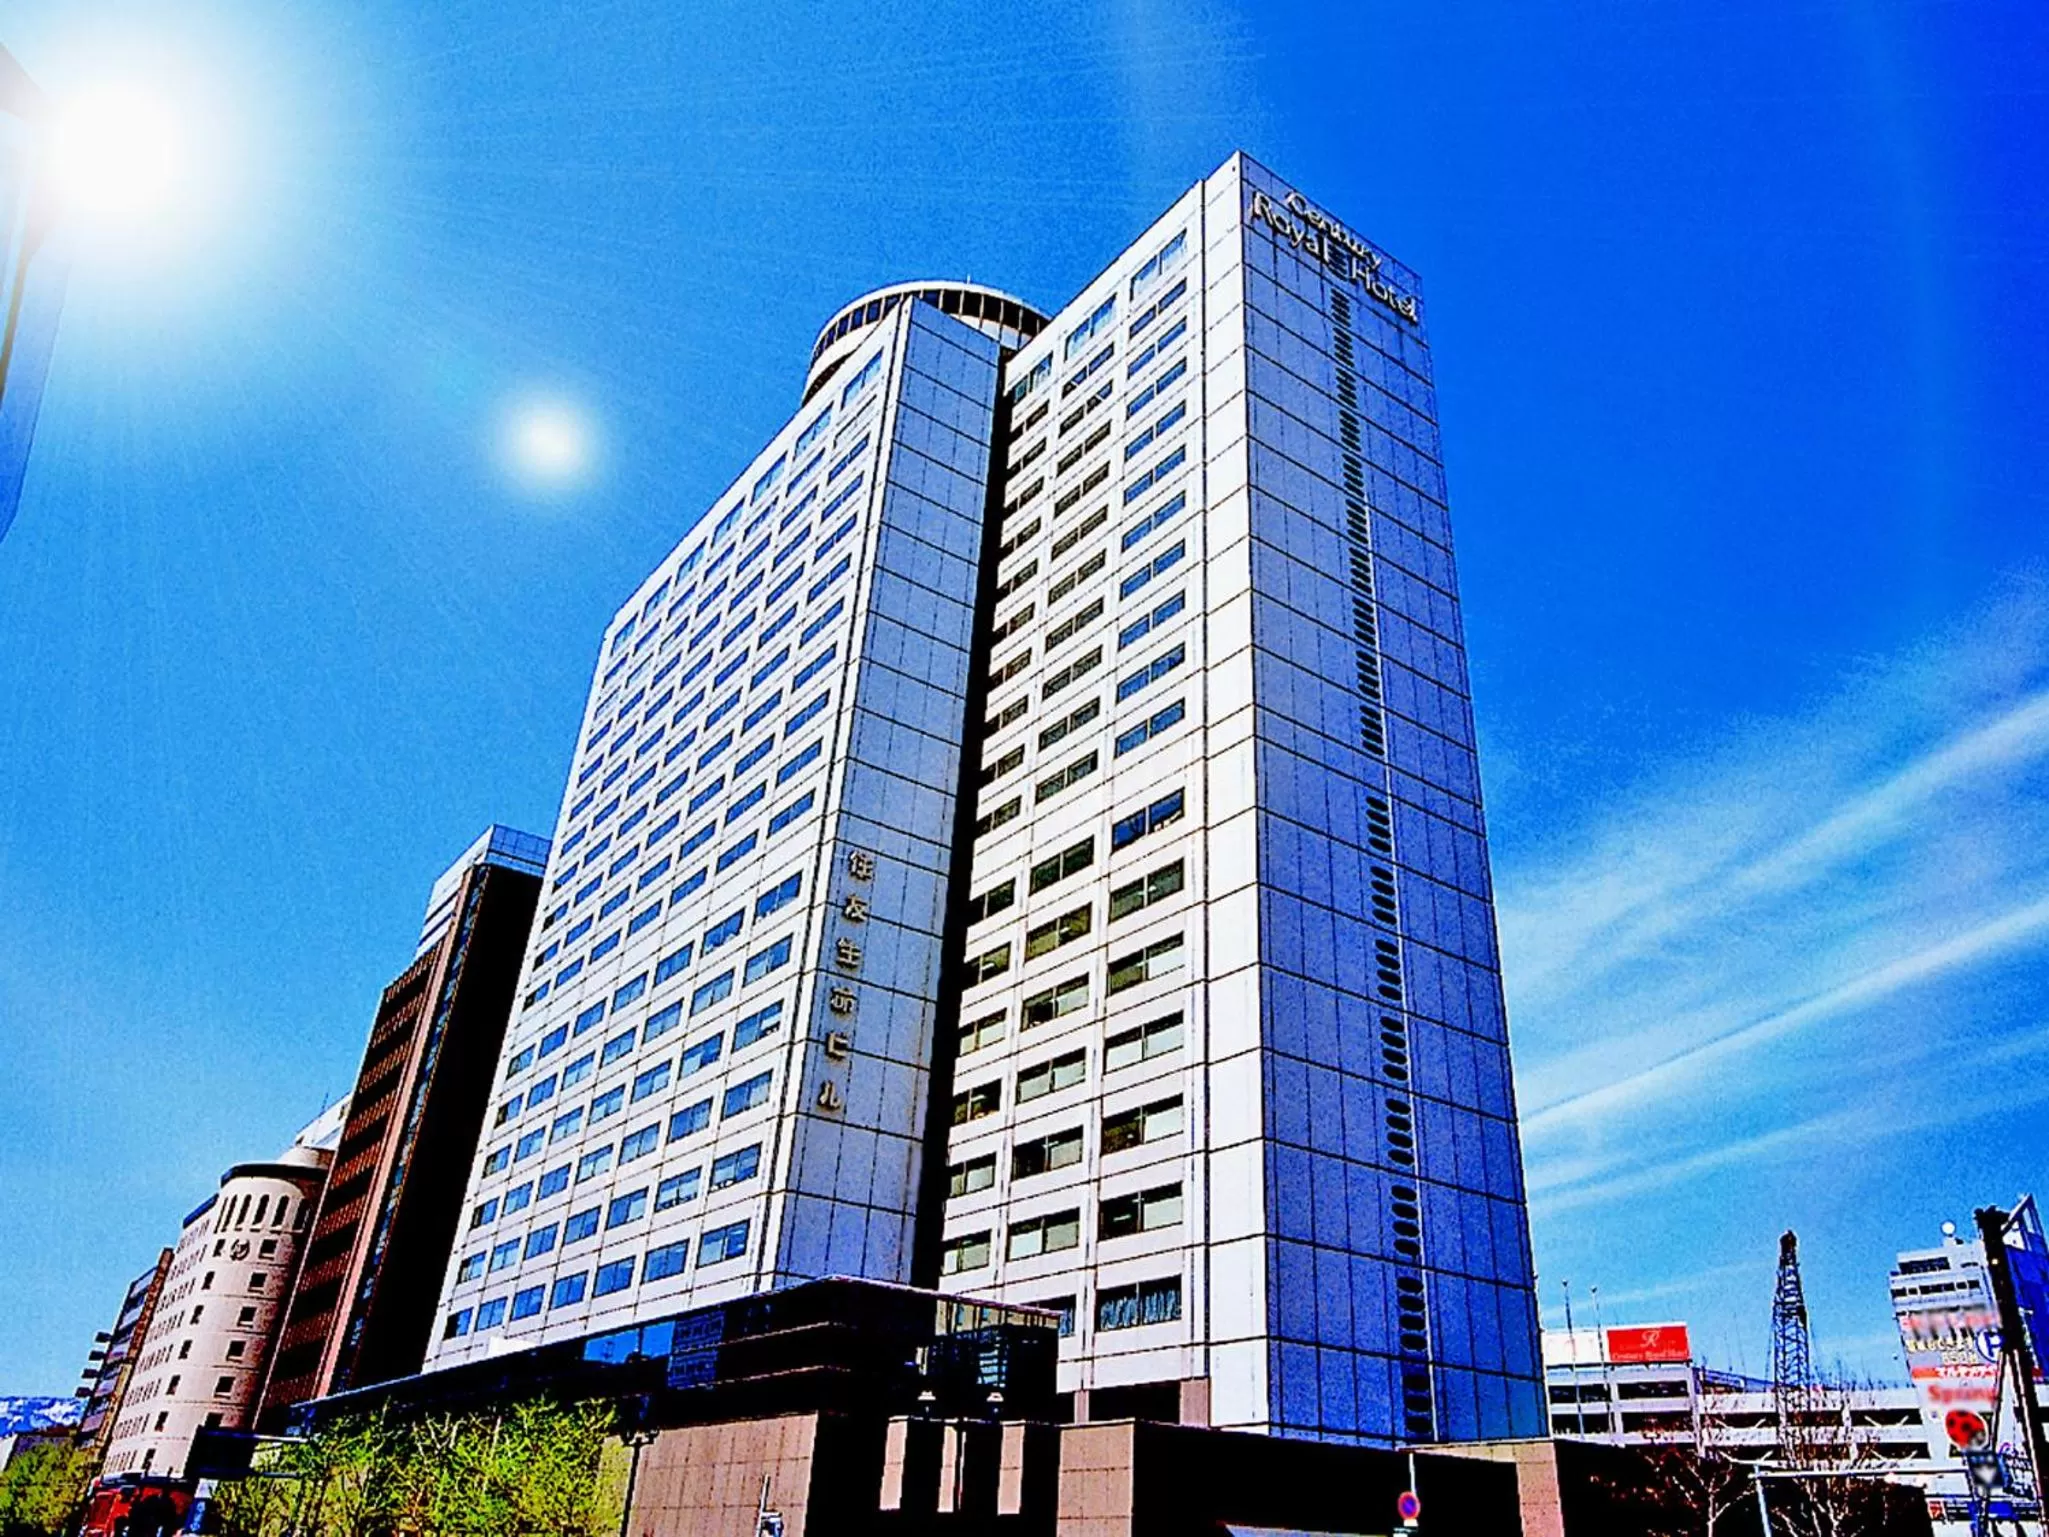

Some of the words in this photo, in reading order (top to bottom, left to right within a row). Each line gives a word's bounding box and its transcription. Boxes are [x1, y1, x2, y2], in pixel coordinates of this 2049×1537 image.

[1251, 191, 1330, 264] Royal
[1351, 257, 1418, 322] Hotel
[1286, 191, 1382, 269] Century
